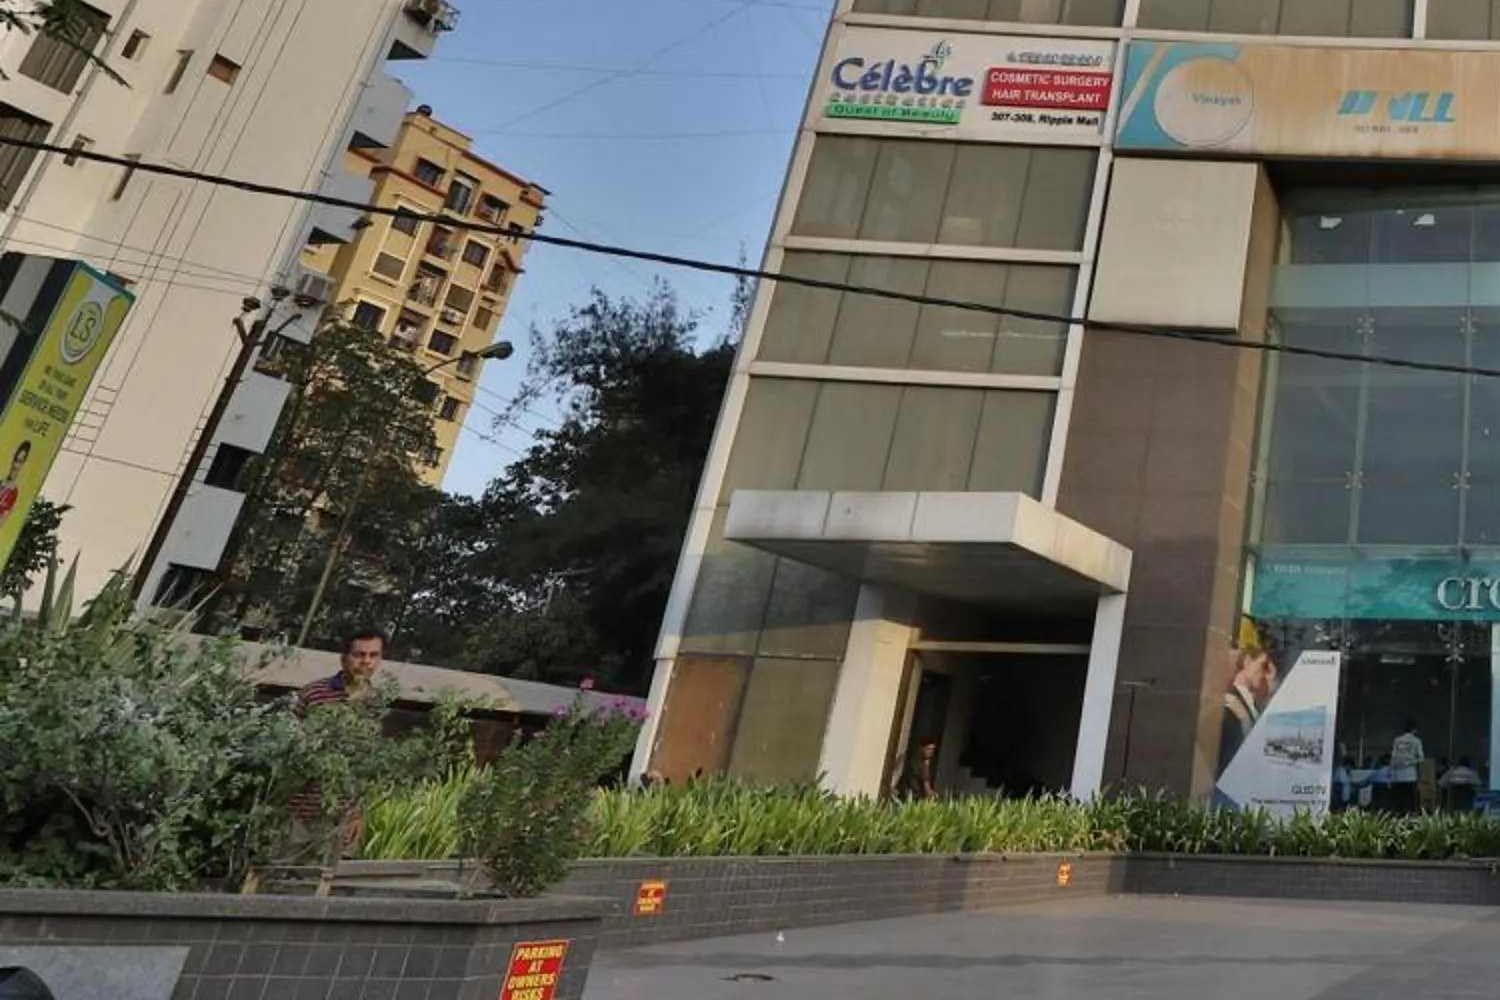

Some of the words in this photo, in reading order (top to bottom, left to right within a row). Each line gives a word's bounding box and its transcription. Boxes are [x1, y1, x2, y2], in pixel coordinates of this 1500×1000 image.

[991, 71, 1051, 85] COSMETIC
[1053, 75, 1111, 87] SURGERY
[992, 88, 1021, 100] HAIR
[1024, 89, 1101, 104] TRANSPLANT
[1038, 114, 1073, 125] Ripple
[515, 945, 565, 961] PARKING
[527, 959, 545, 974] AT
[507, 971, 557, 990] OWNERS
